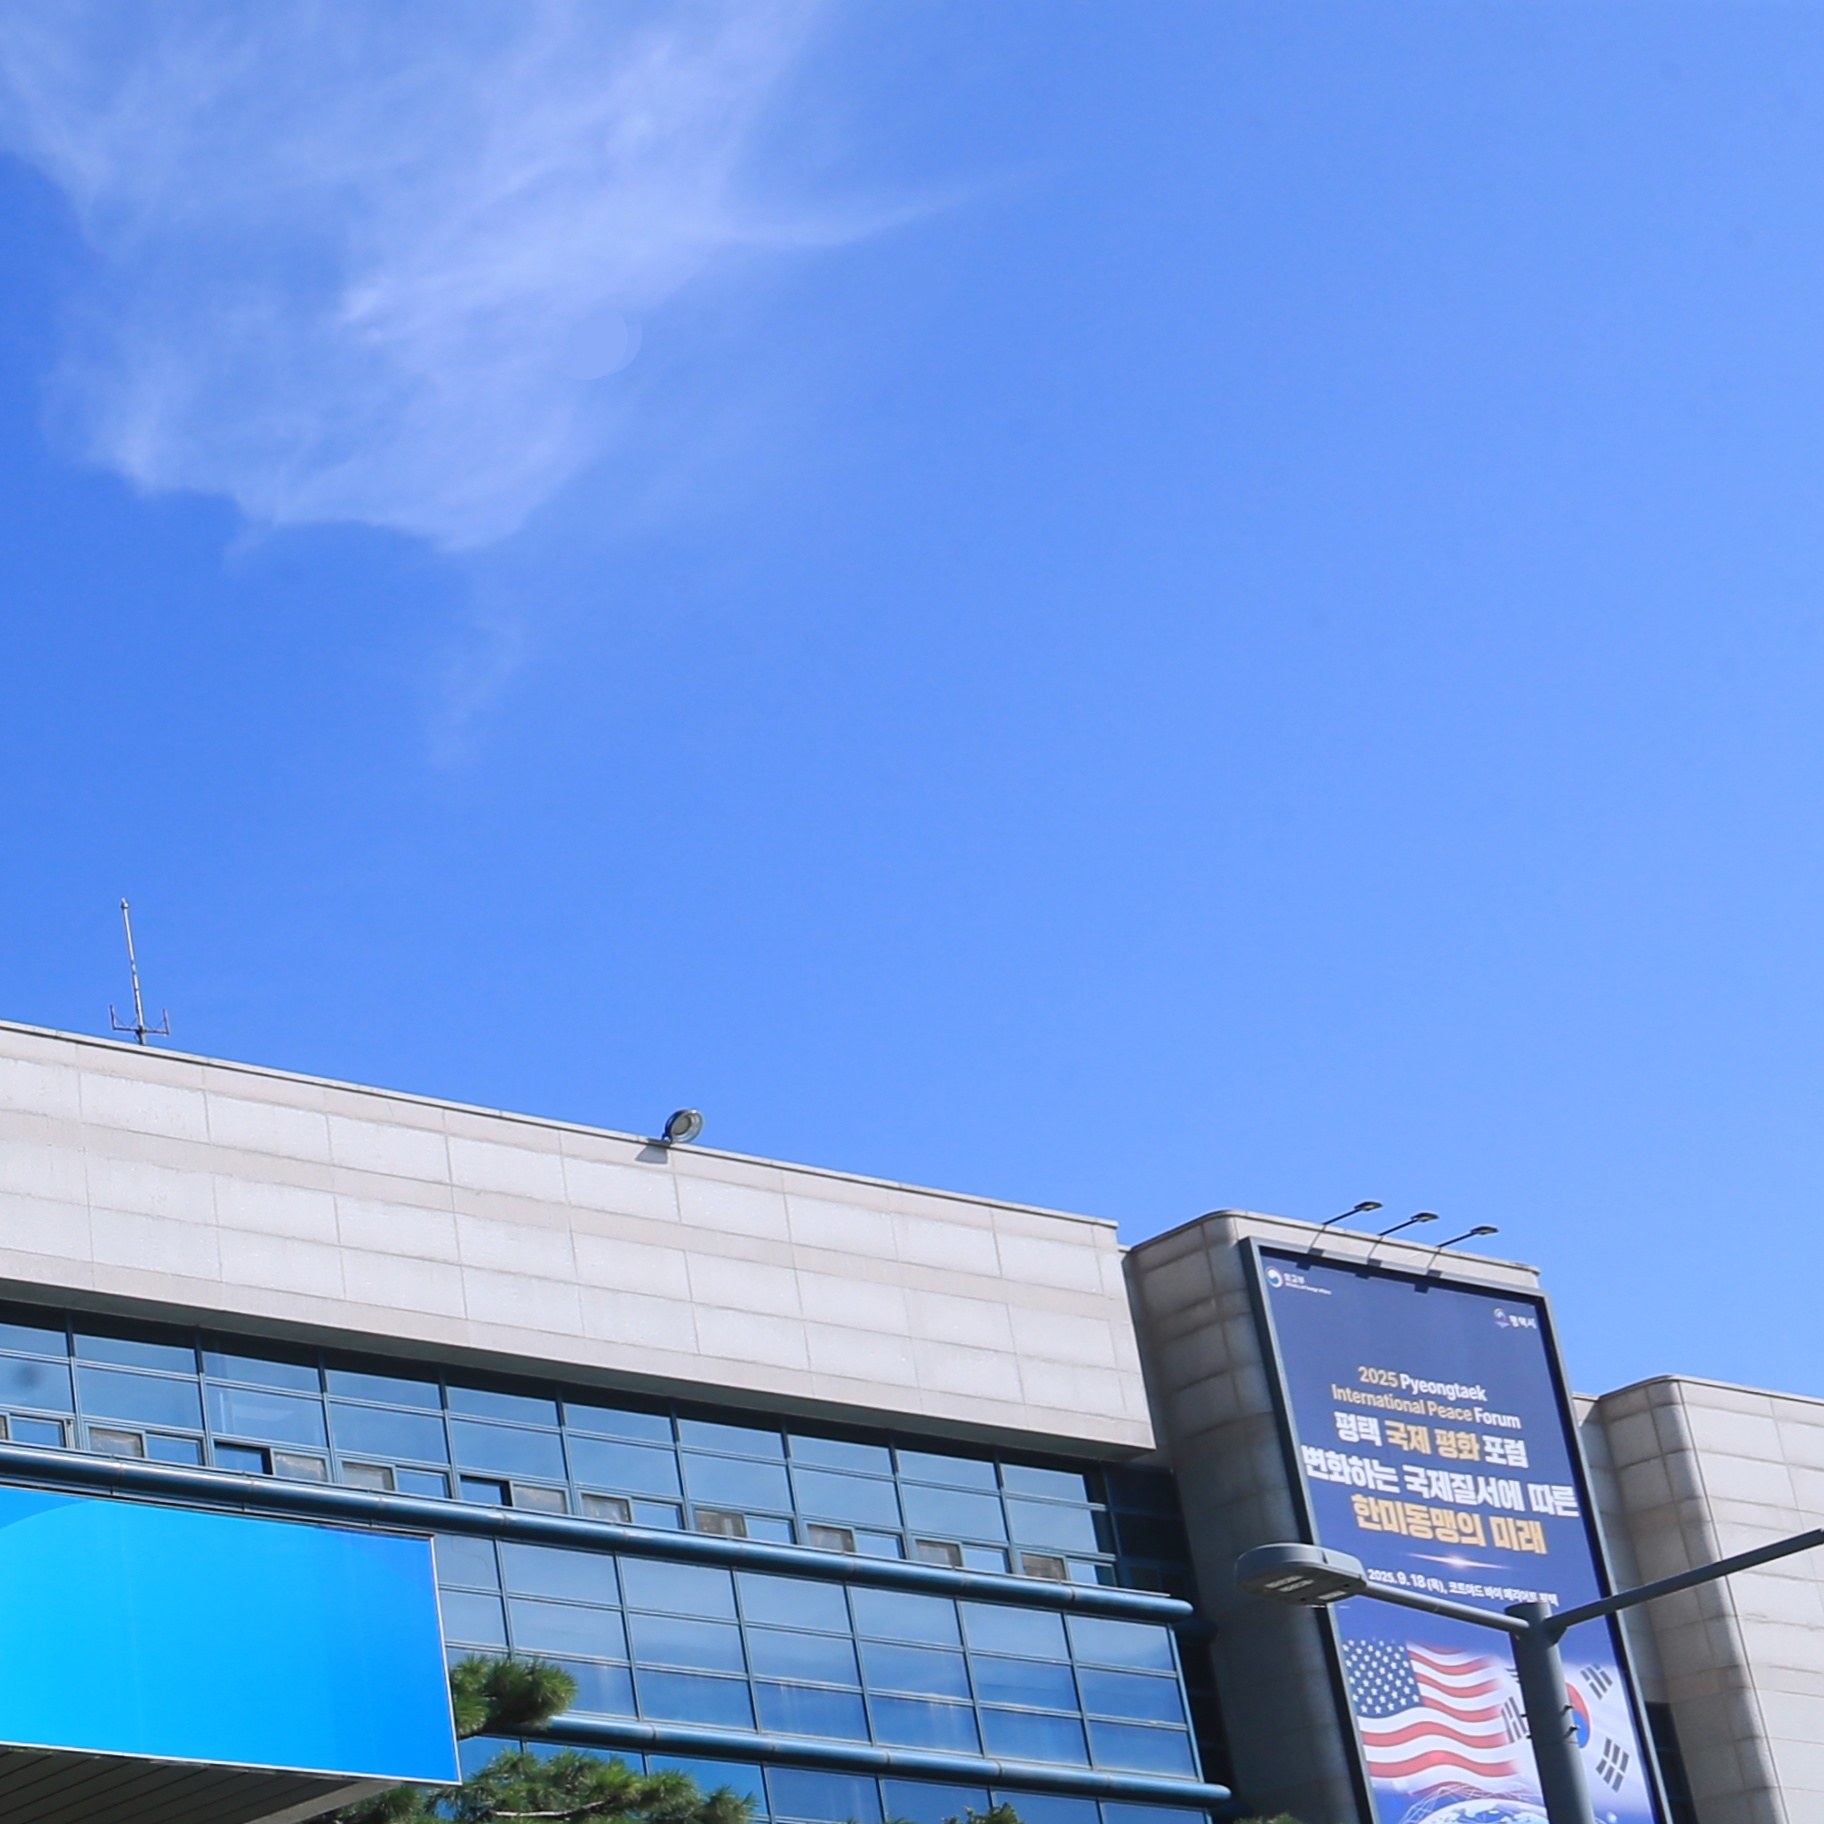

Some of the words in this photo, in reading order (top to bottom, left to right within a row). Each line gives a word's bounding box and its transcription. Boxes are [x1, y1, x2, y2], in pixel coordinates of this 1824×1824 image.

[1331, 1384, 1425, 1416] International
[1427, 1401, 1473, 1422] Peace
[1474, 1407, 1521, 1430] Forum
[1358, 1366, 1398, 1388] 2025
[1400, 1373, 1488, 1402] Pyeongtaek
[1334, 1411, 1382, 1447] 평택
[1384, 1420, 1432, 1455] 국제
[1434, 1428, 1480, 1461] 평화
[1482, 1435, 1529, 1468] 포럼
[1301, 1445, 1400, 1494] 변화하는
[1402, 1464, 1525, 1512] 국제질서에
[1527, 1482, 1580, 1517] 따른
[1351, 1493, 1487, 1547] 한미동맹의
[1489, 1515, 1548, 1554] 미래
